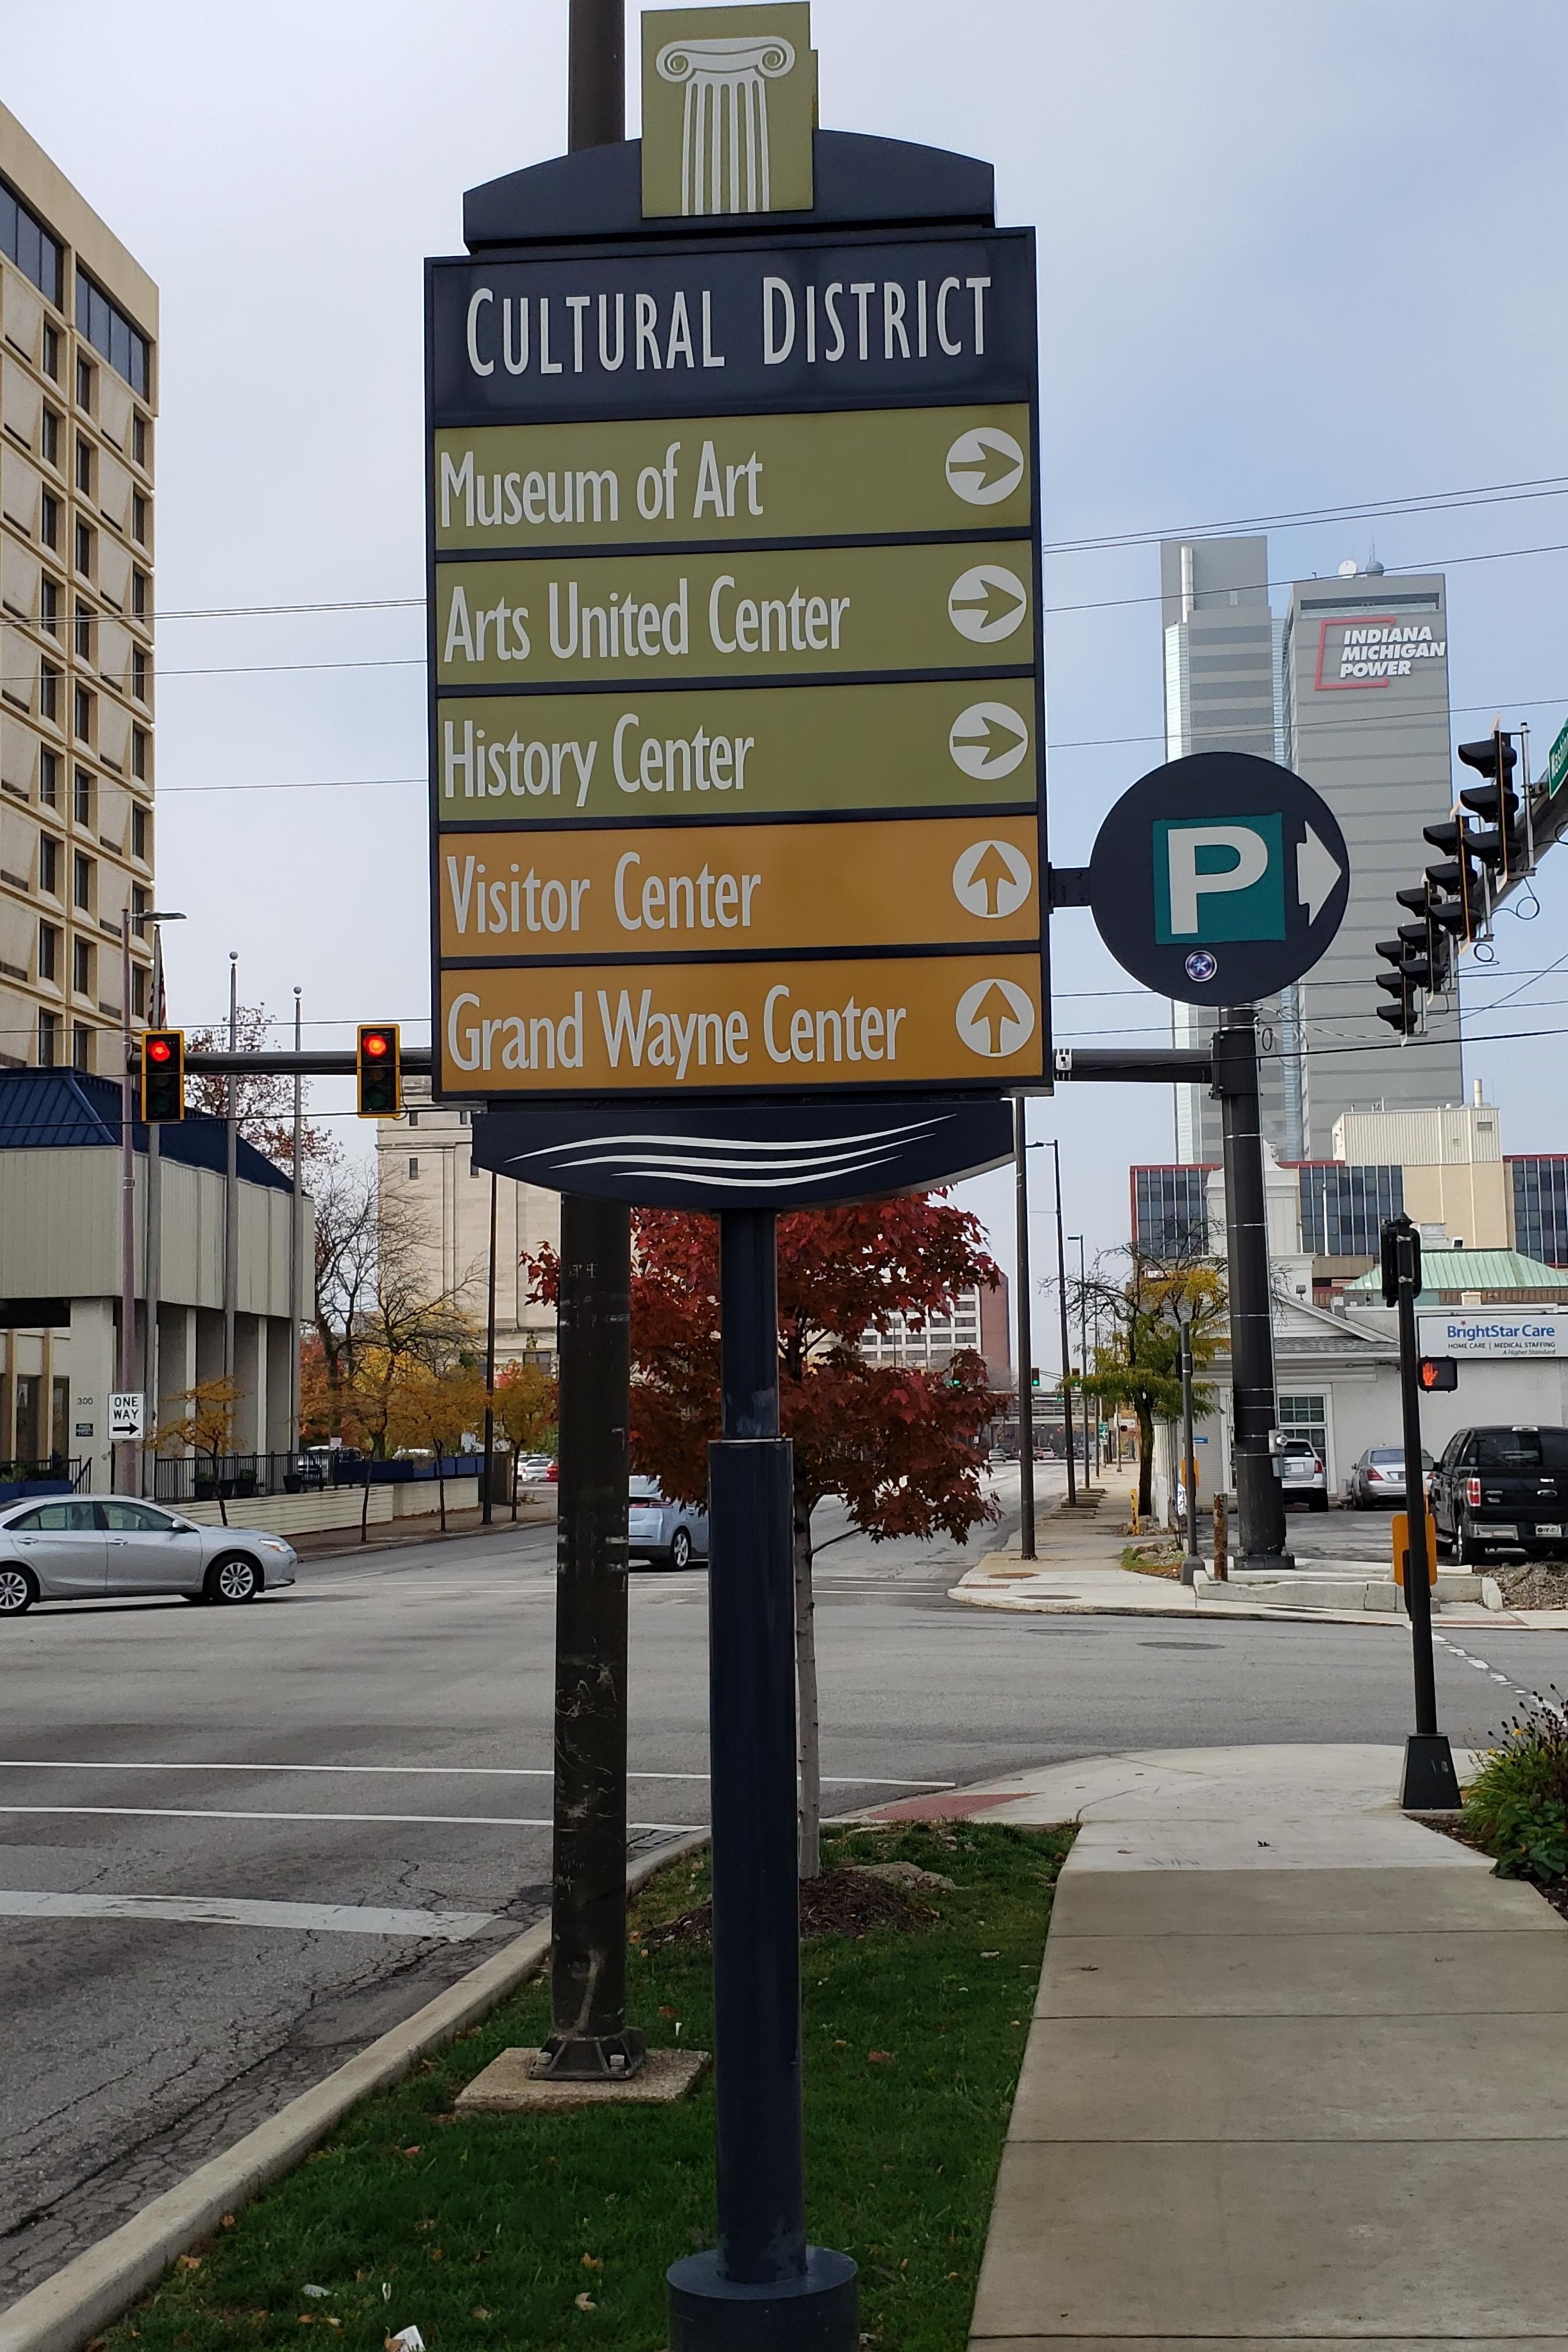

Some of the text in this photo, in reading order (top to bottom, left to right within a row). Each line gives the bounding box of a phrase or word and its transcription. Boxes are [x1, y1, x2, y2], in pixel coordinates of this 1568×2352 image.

[467, 277, 991, 376] CULTURAL DISTRICT
[441, 441, 763, 527] Museum of Art
[444, 575, 850, 662] Arts United Center
[1344, 626, 1432, 645] INDIANA
[1340, 660, 1411, 678] POWER
[1341, 642, 1446, 661] MICHIGAN
[444, 713, 754, 807] History Center
[447, 852, 761, 933] Visitor Center
[1168, 826, 1268, 935] P
[448, 985, 906, 1079] Grand Wayne Center
[1447, 1324, 1555, 1341] BrightStar Care
[77, 1397, 93, 1405] 300
[114, 1396, 138, 1407] ONE
[114, 1409, 139, 1419] WAY
